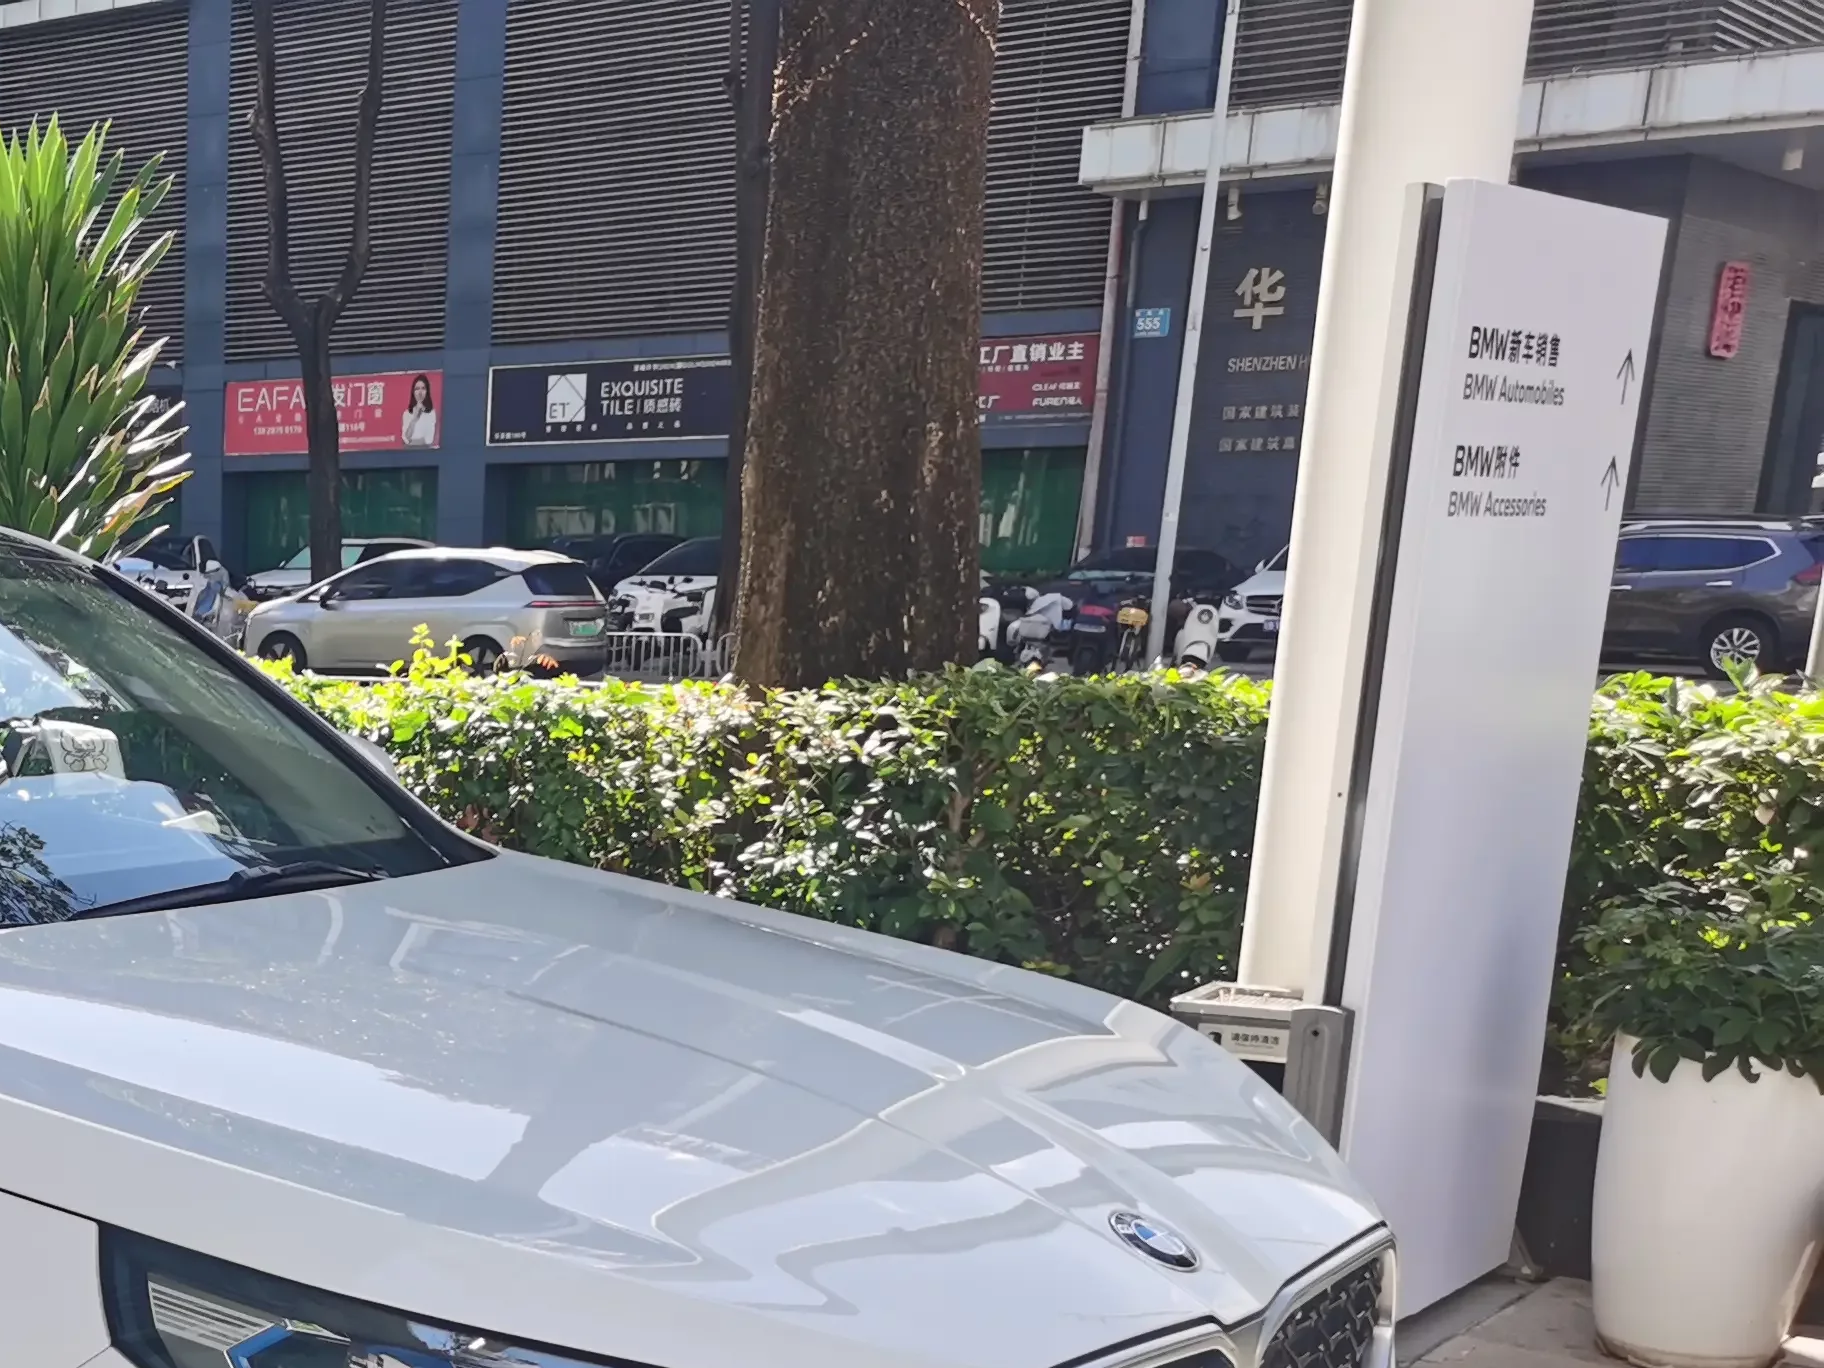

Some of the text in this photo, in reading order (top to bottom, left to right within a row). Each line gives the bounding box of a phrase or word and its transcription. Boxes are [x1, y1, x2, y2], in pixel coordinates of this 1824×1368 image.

[1233, 268, 1286, 330] 华
[1227, 356, 1297, 373] SHENZHEN
[600, 378, 684, 398] EXQUISITE
[1462, 373, 1565, 406] BMW Automobiles
[600, 399, 634, 416] TILE
[1452, 445, 1520, 479] BMW附件
[1447, 490, 1547, 517] BMW Accessories
